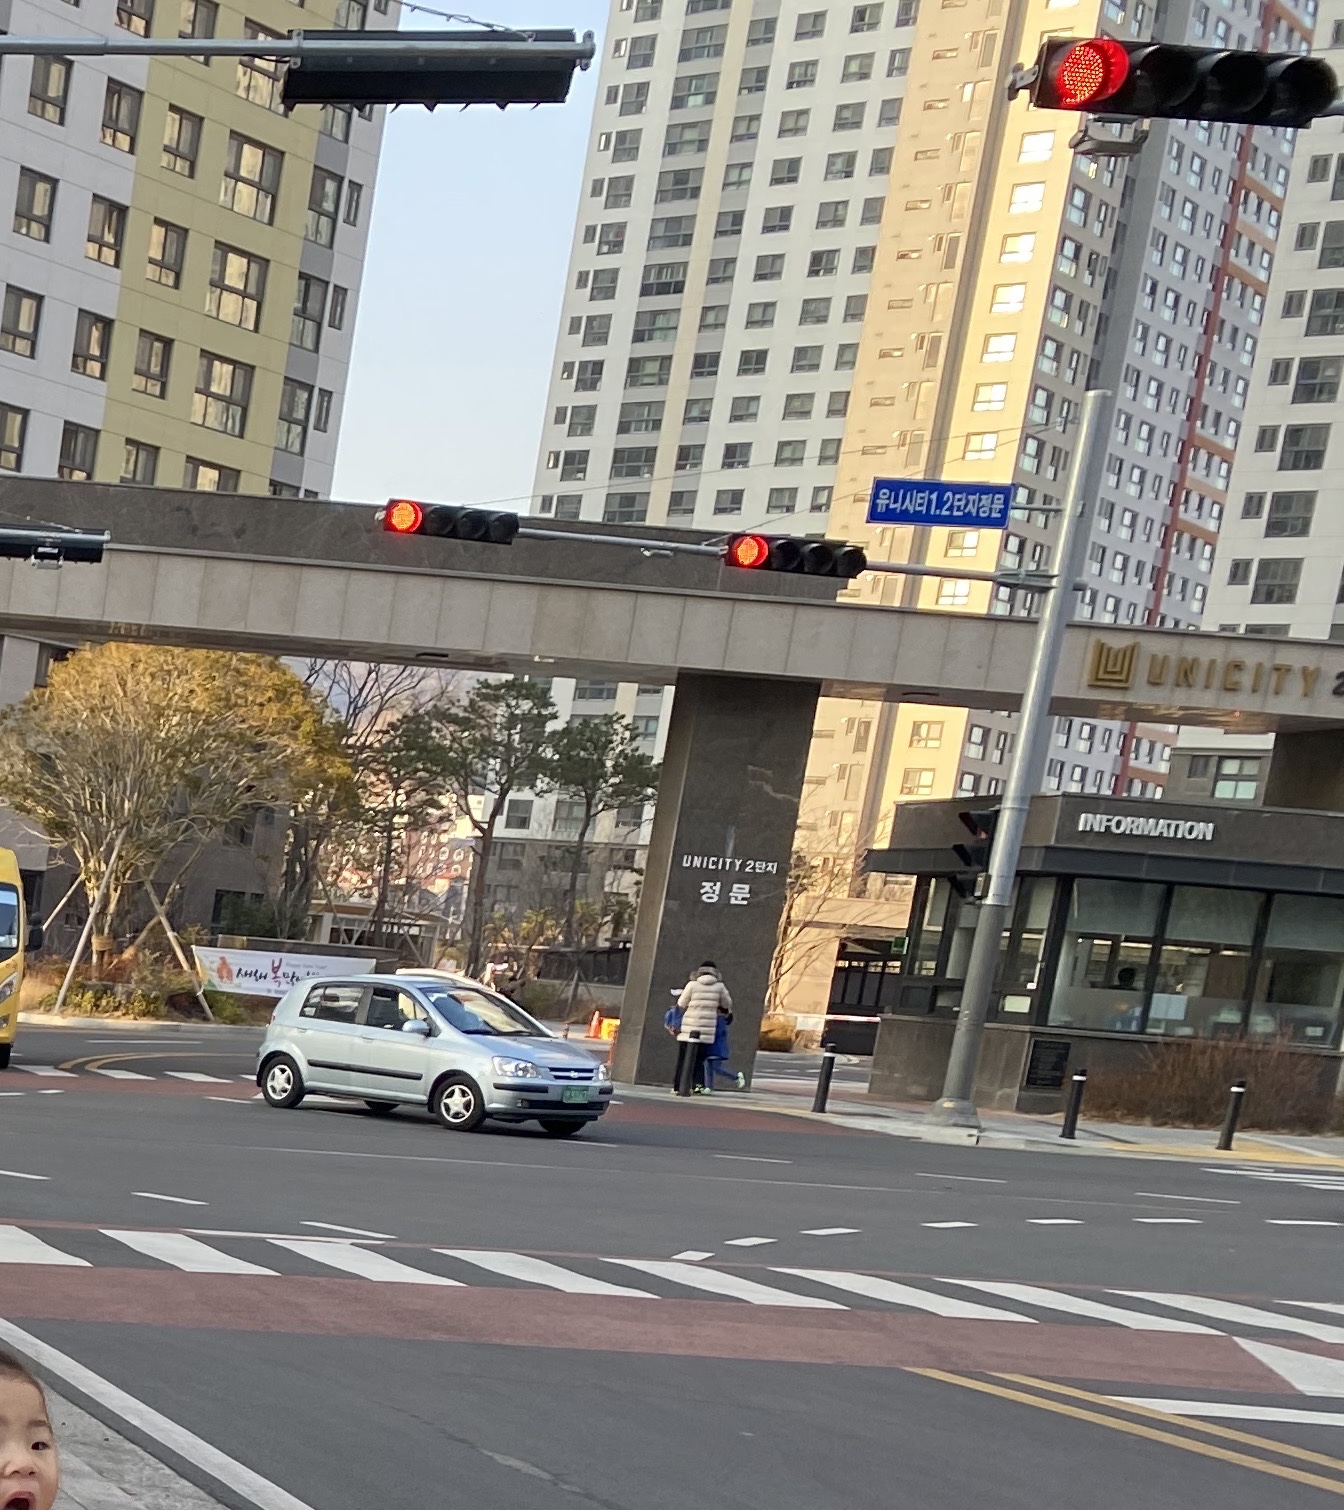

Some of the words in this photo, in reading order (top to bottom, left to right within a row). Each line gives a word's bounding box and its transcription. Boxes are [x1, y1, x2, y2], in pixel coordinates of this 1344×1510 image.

[1146, 653, 1321, 697] UNICITY
[1078, 812, 1215, 841] INFORMATION
[682, 854, 743, 872] UNICITY
[744, 860, 779, 875] 2단지
